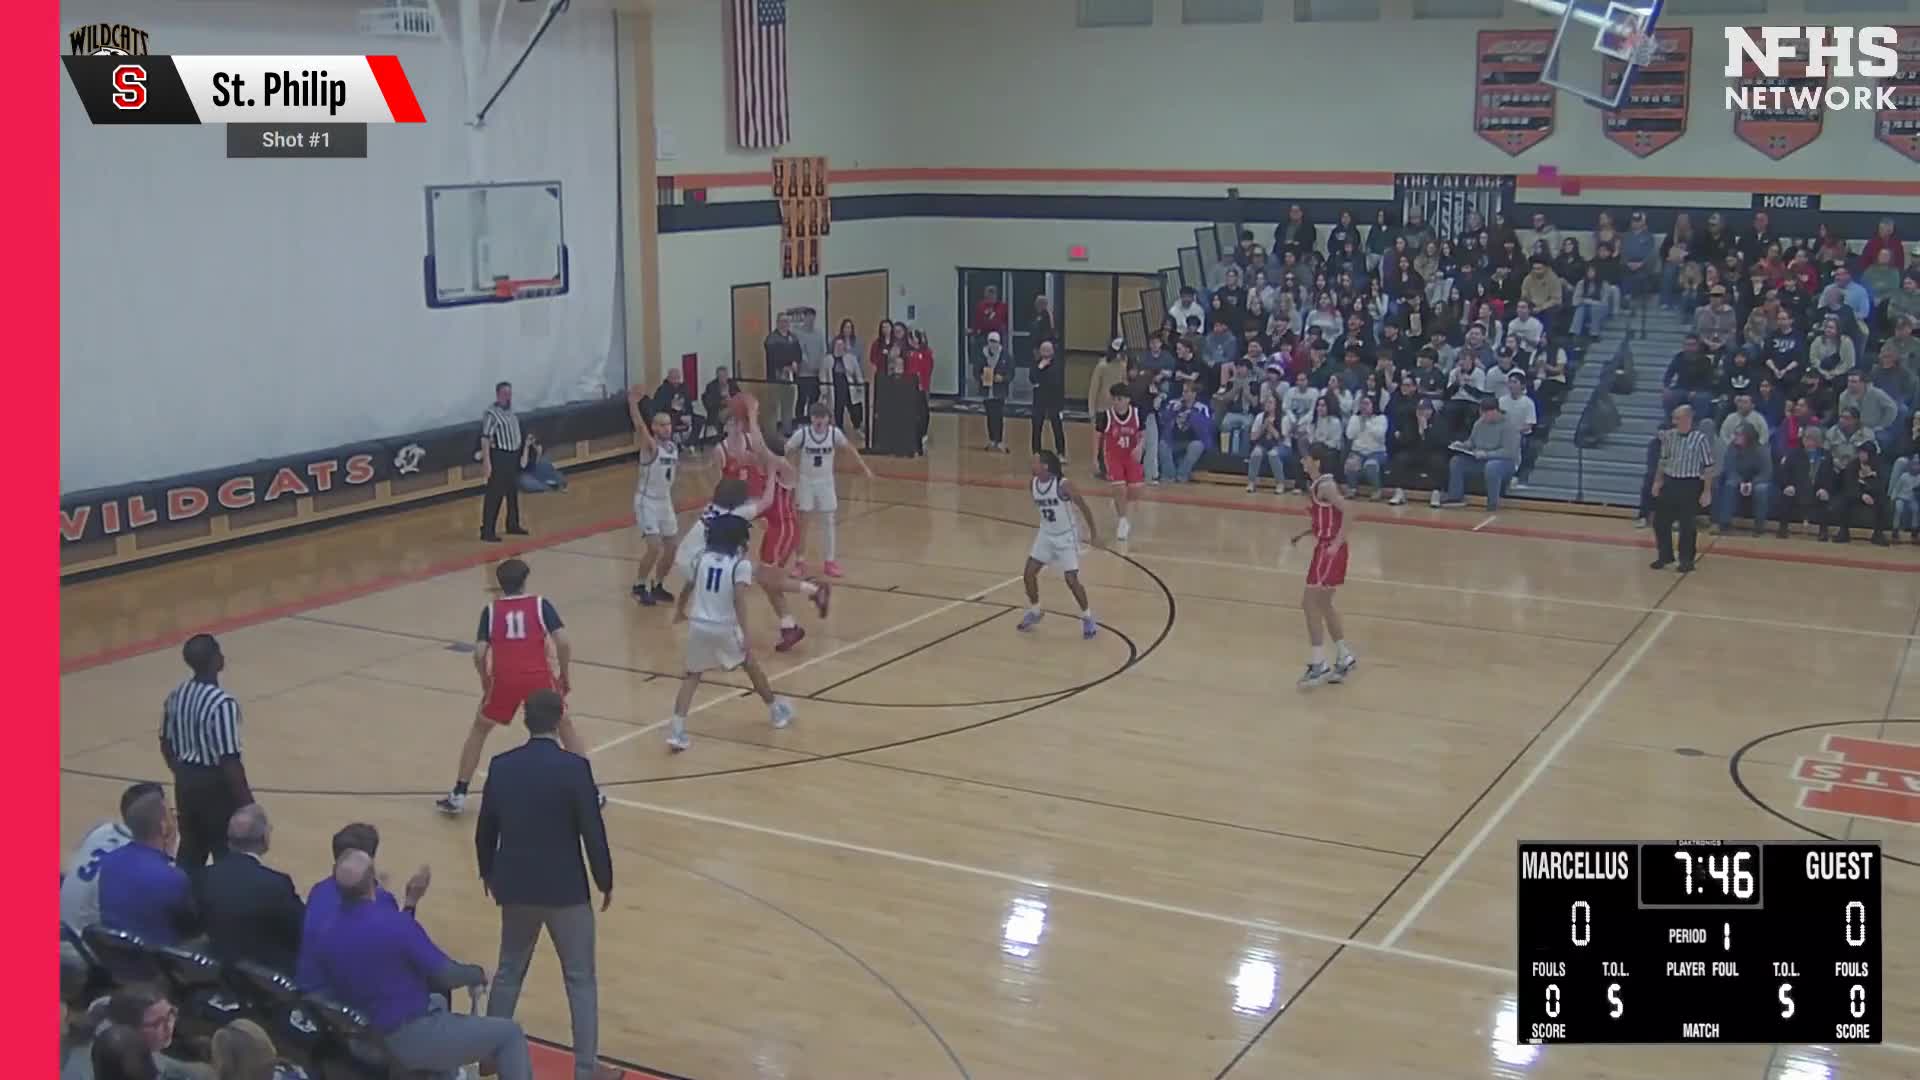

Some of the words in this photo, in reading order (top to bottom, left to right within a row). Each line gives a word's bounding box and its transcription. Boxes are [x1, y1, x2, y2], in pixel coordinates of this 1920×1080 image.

[1763, 195, 1808, 209] HOME
[60, 454, 376, 541] WILDCATS
[706, 567, 723, 593] 11
[504, 609, 527, 640] 11
